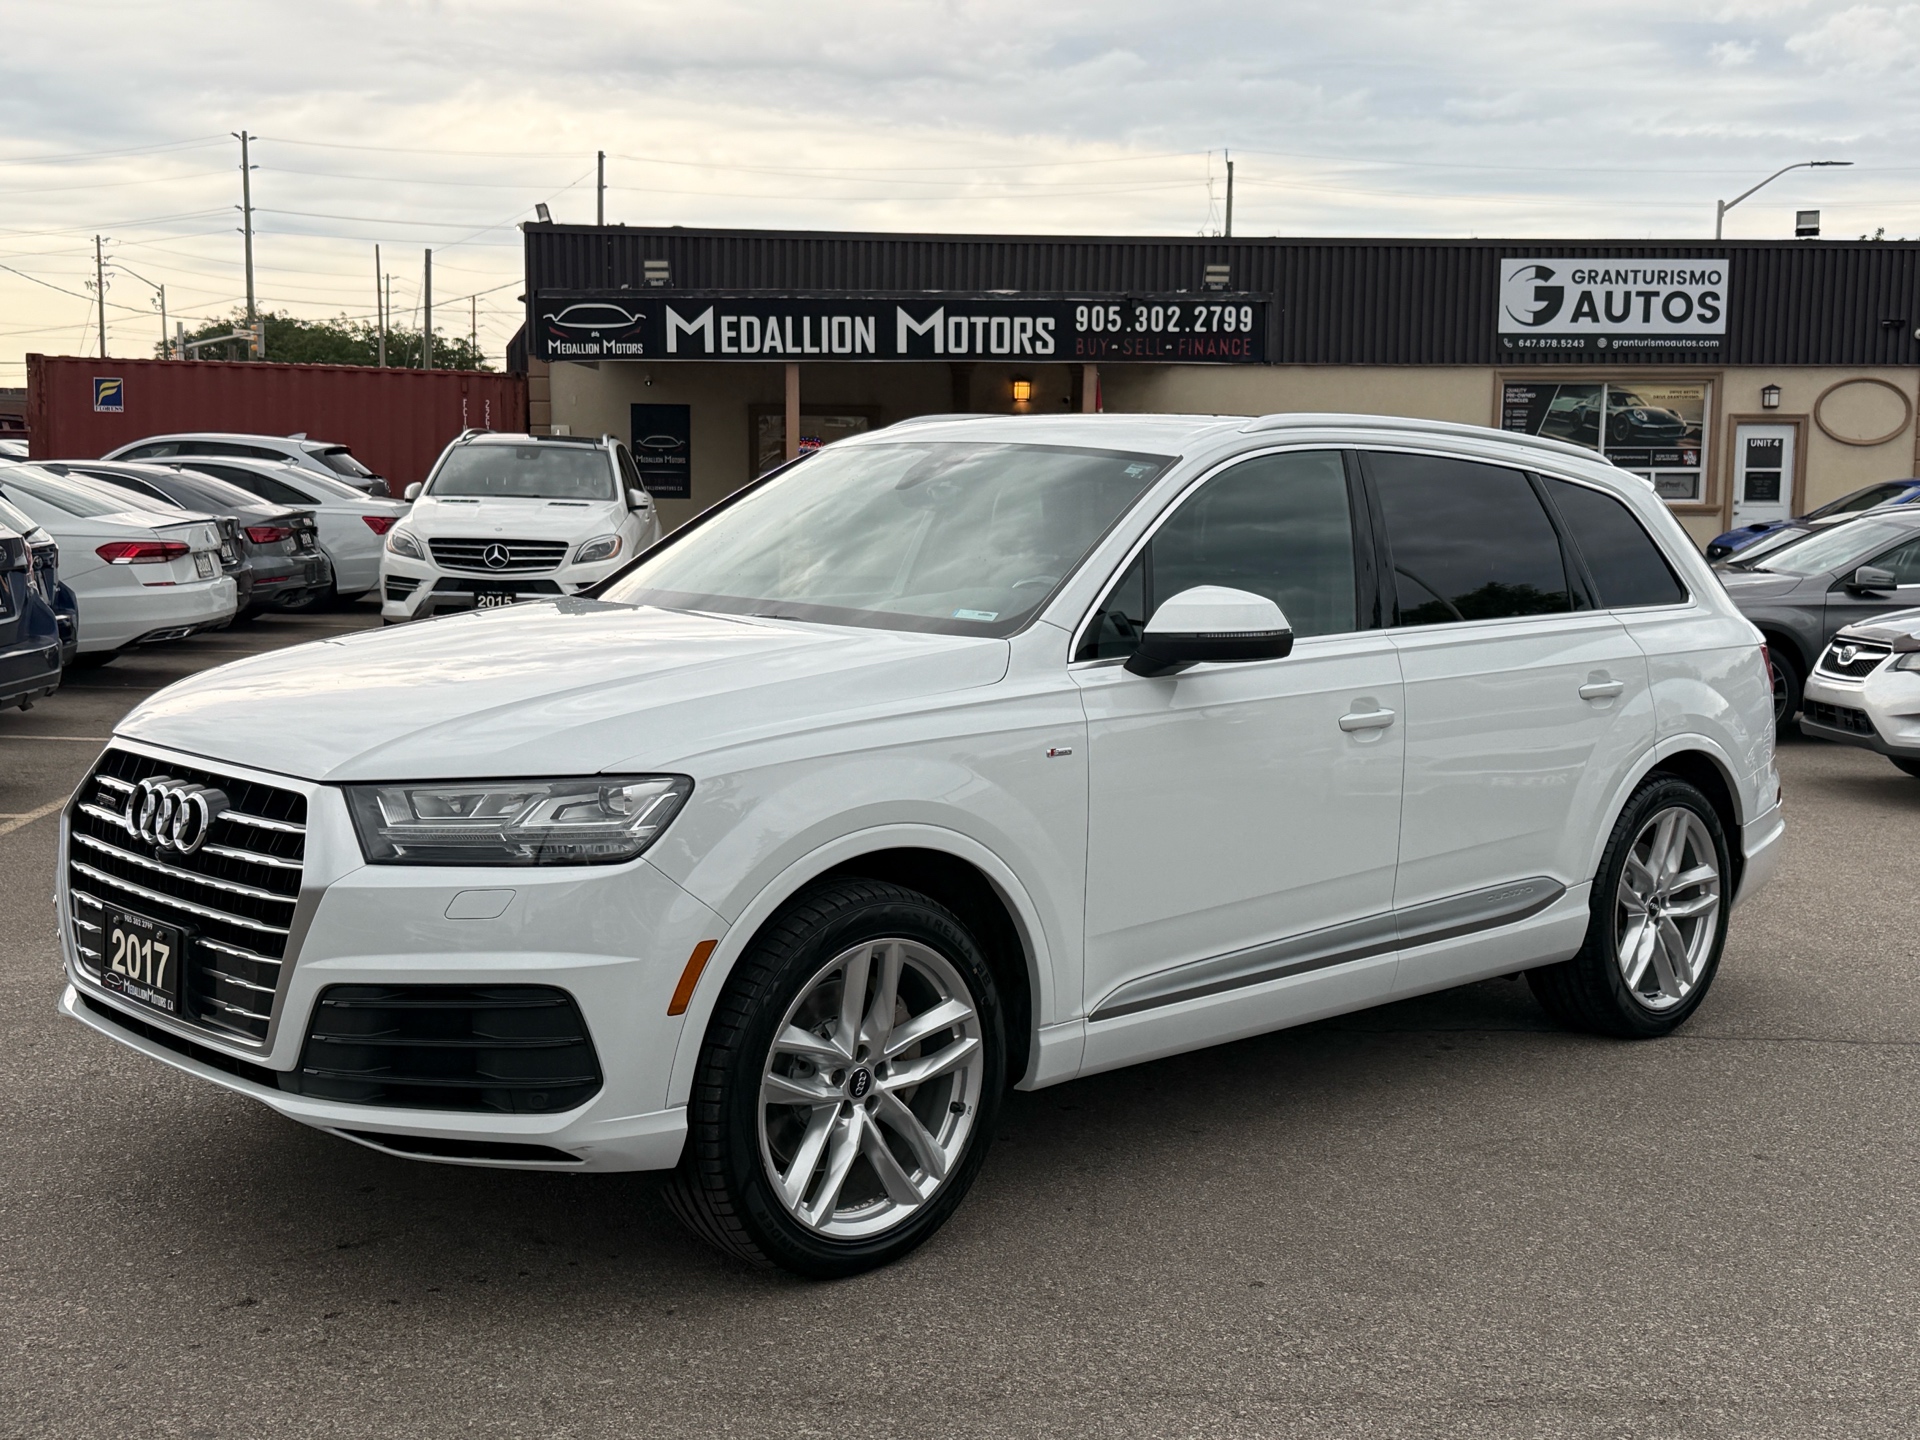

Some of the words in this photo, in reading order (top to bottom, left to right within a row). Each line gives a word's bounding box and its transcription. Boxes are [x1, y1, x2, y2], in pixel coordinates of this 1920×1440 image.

[1571, 269, 1722, 286] GRANTURISMO
[1569, 290, 1721, 324] AUTOS
[1075, 305, 1253, 333] 905.302.2799
[665, 304, 876, 354] MEDALLION
[896, 305, 1056, 355] MOTORS
[547, 339, 600, 354] MEDALLION
[602, 339, 644, 354] MOTORS
[1518, 339, 1586, 348] 647.878.5243
[1612, 339, 1720, 349] granturismoautos.com
[1750, 439, 1772, 447] UNIT
[1773, 439, 1780, 447] 4
[477, 596, 512, 608] 2015
[112, 928, 170, 989] 2017
